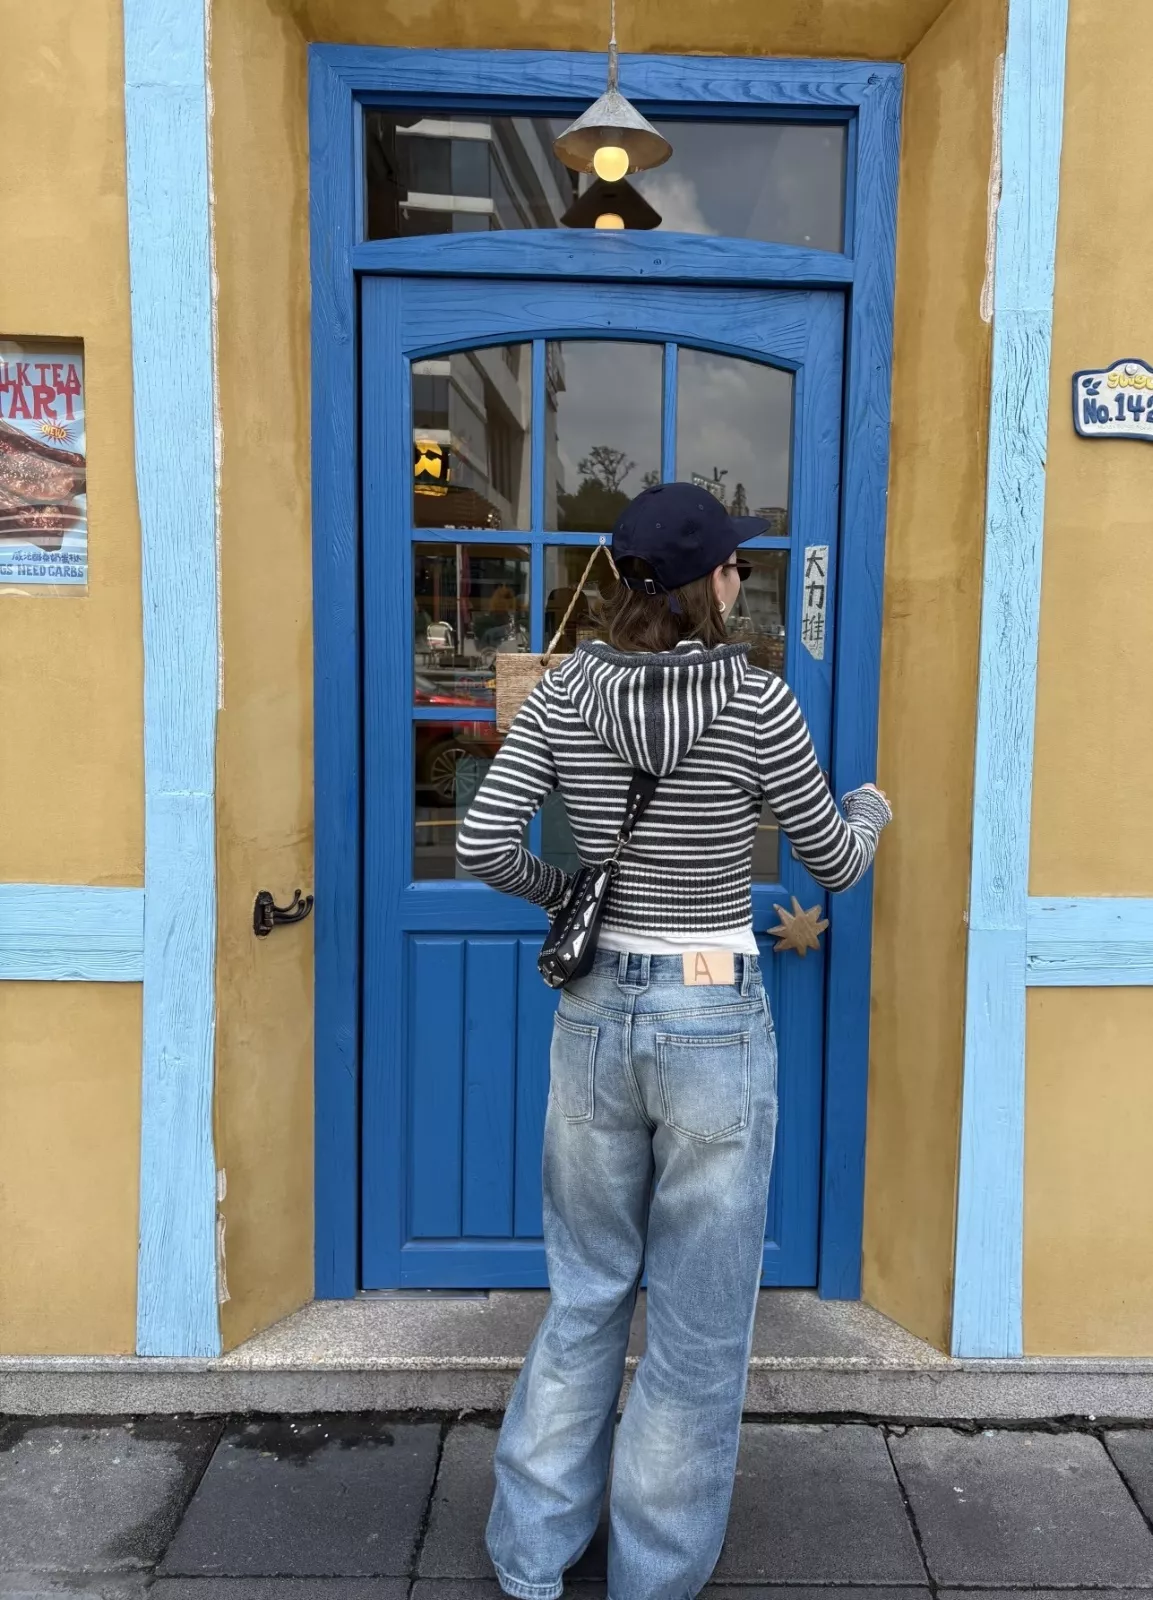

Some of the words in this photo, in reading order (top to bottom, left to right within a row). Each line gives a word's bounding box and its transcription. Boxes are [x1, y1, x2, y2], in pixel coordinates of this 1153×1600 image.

[34, 363, 81, 388] TEA
[17, 564, 46, 576] NEED
[48, 565, 84, 577] CARBS
[694, 951, 713, 985] A
